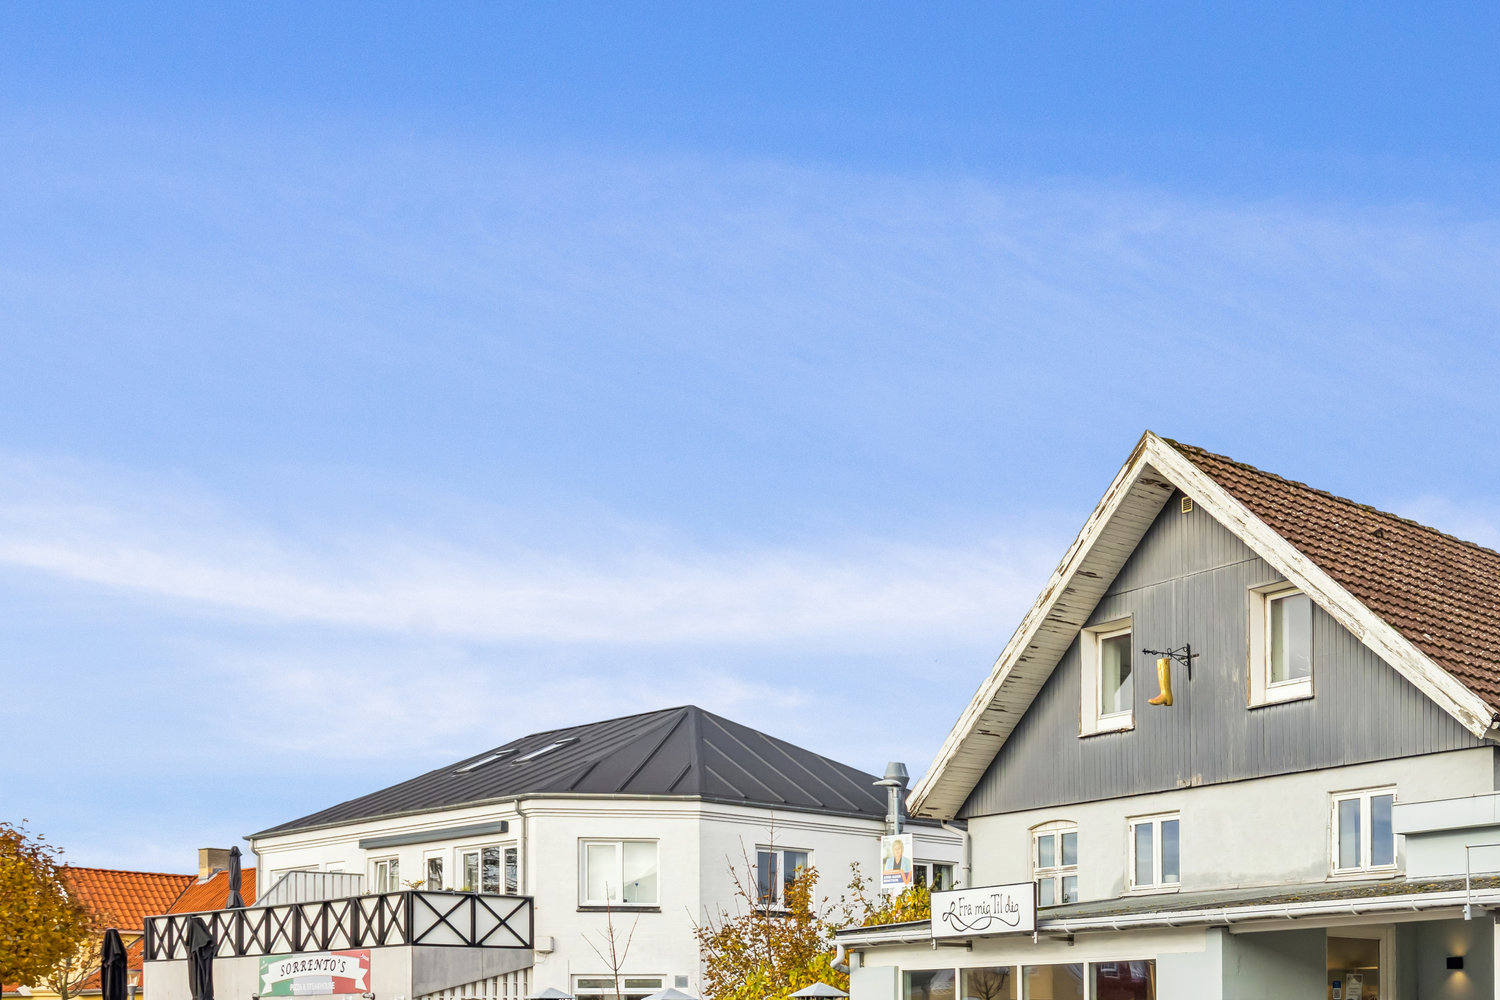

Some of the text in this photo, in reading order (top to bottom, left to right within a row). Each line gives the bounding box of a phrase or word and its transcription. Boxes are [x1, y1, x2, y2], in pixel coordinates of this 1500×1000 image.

[958, 897, 973, 917] Fra
[990, 893, 1003, 914] Til
[280, 958, 347, 977] SORRENTO'S
